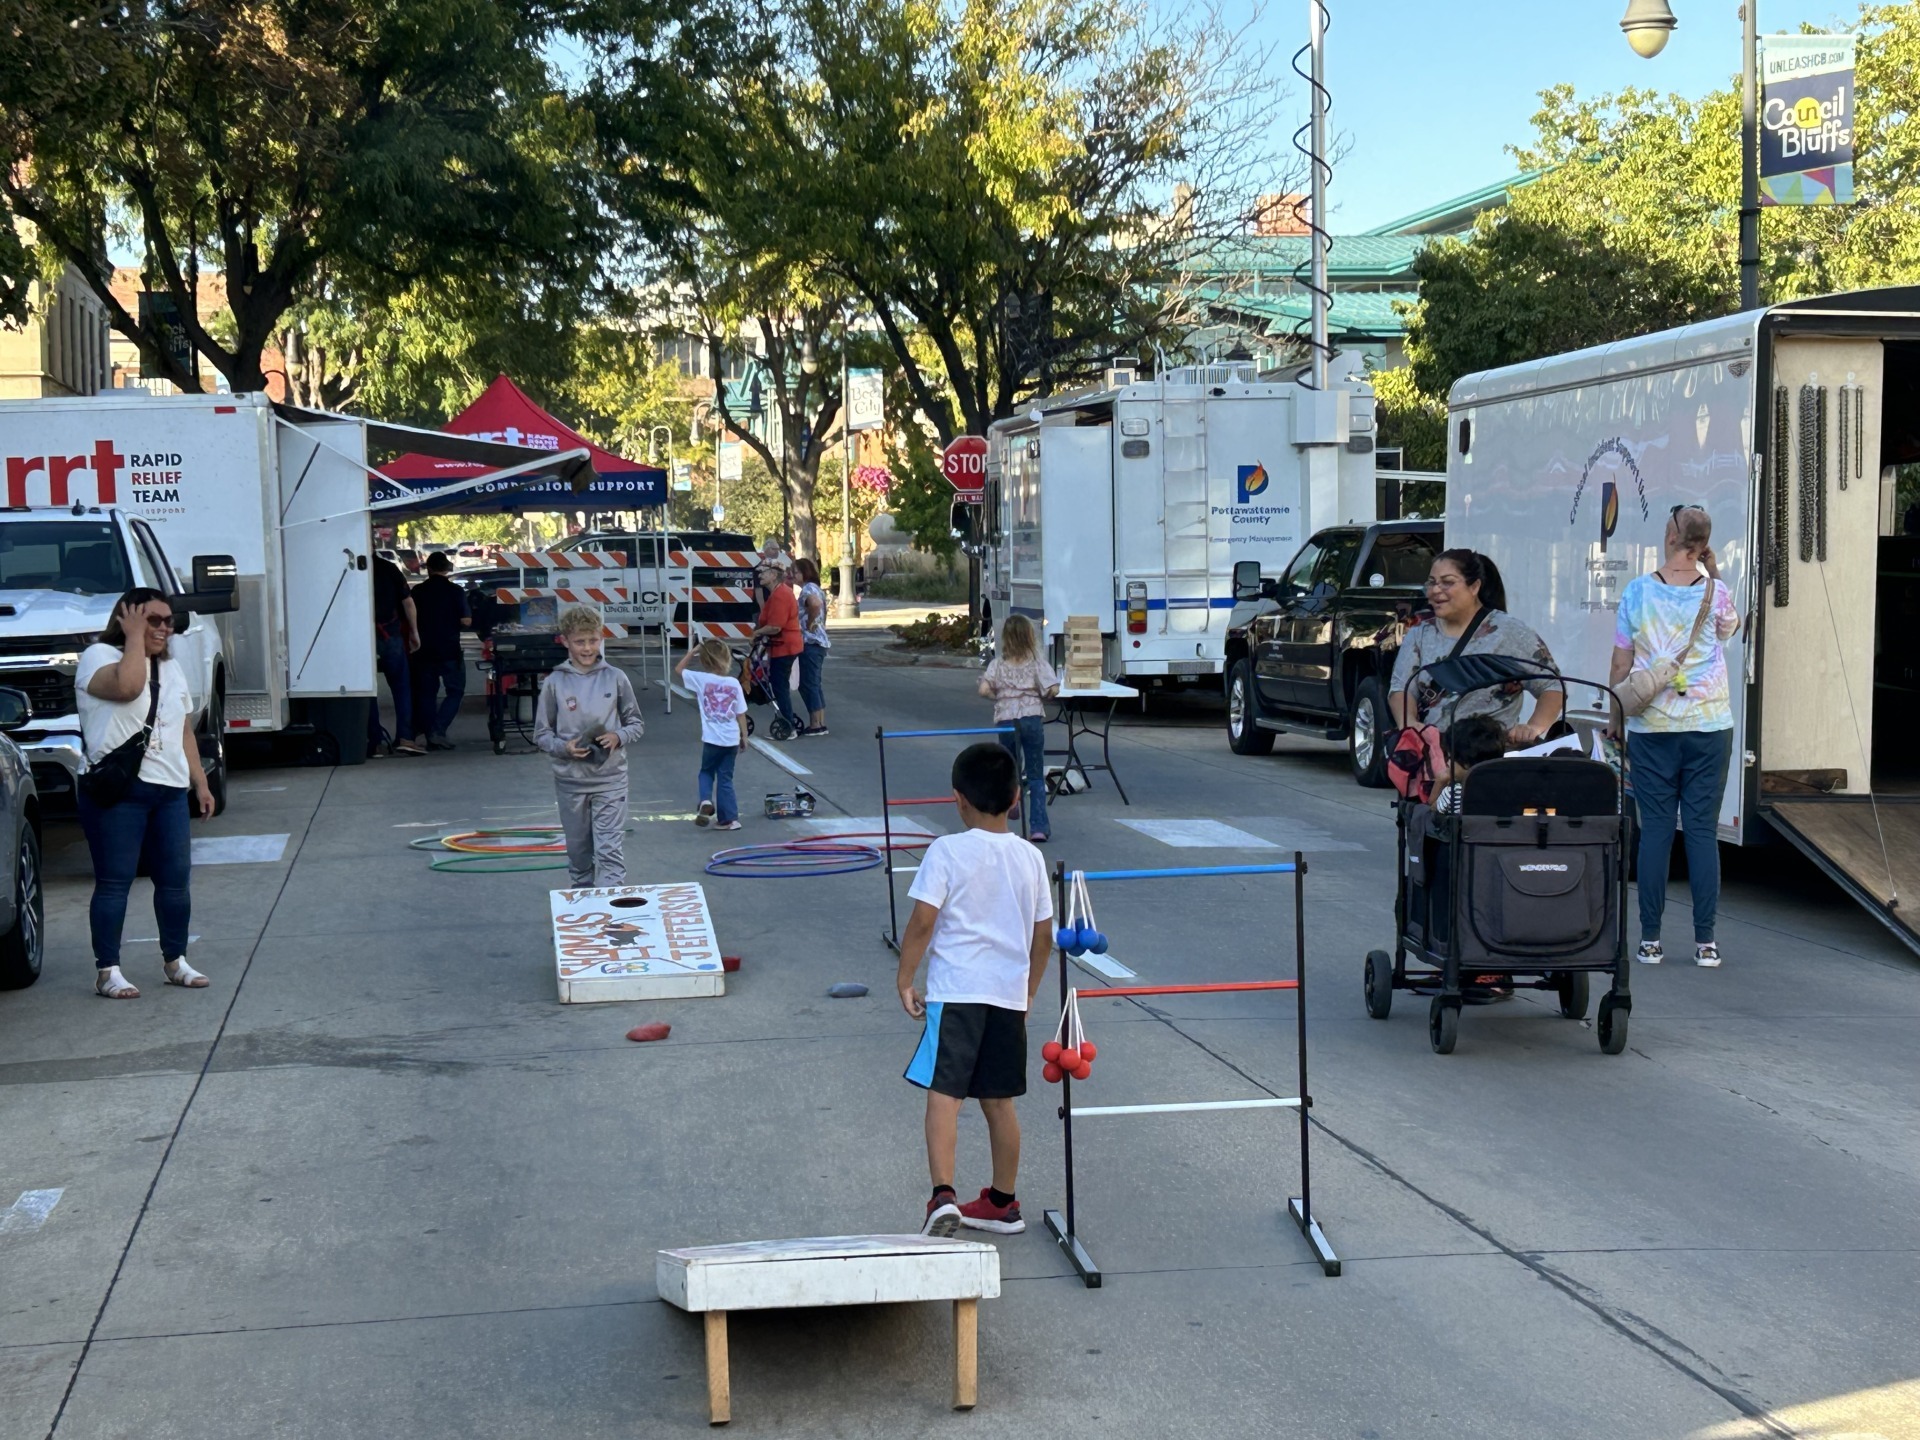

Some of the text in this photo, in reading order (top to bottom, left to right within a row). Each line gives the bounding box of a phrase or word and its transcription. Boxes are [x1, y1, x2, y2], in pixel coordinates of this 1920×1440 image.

[1770, 52, 1845, 74] UNLEASHCB.COM
[1763, 86, 1845, 130] Council
[1777, 119, 1851, 158] Bluffs
[854, 400, 881, 416] City
[130, 453, 183, 468] RAPID
[6, 440, 126, 507] rrt
[131, 471, 183, 485] RELIEF
[589, 481, 655, 491] SUPPORT
[132, 489, 180, 503] TEAM
[1211, 506, 1290, 514] Pottawattamie
[1232, 515, 1271, 524] County
[558, 886, 656, 904] YELLOW
[656, 885, 713, 961] JEFFERSON
[555, 911, 613, 977] THOMAS
